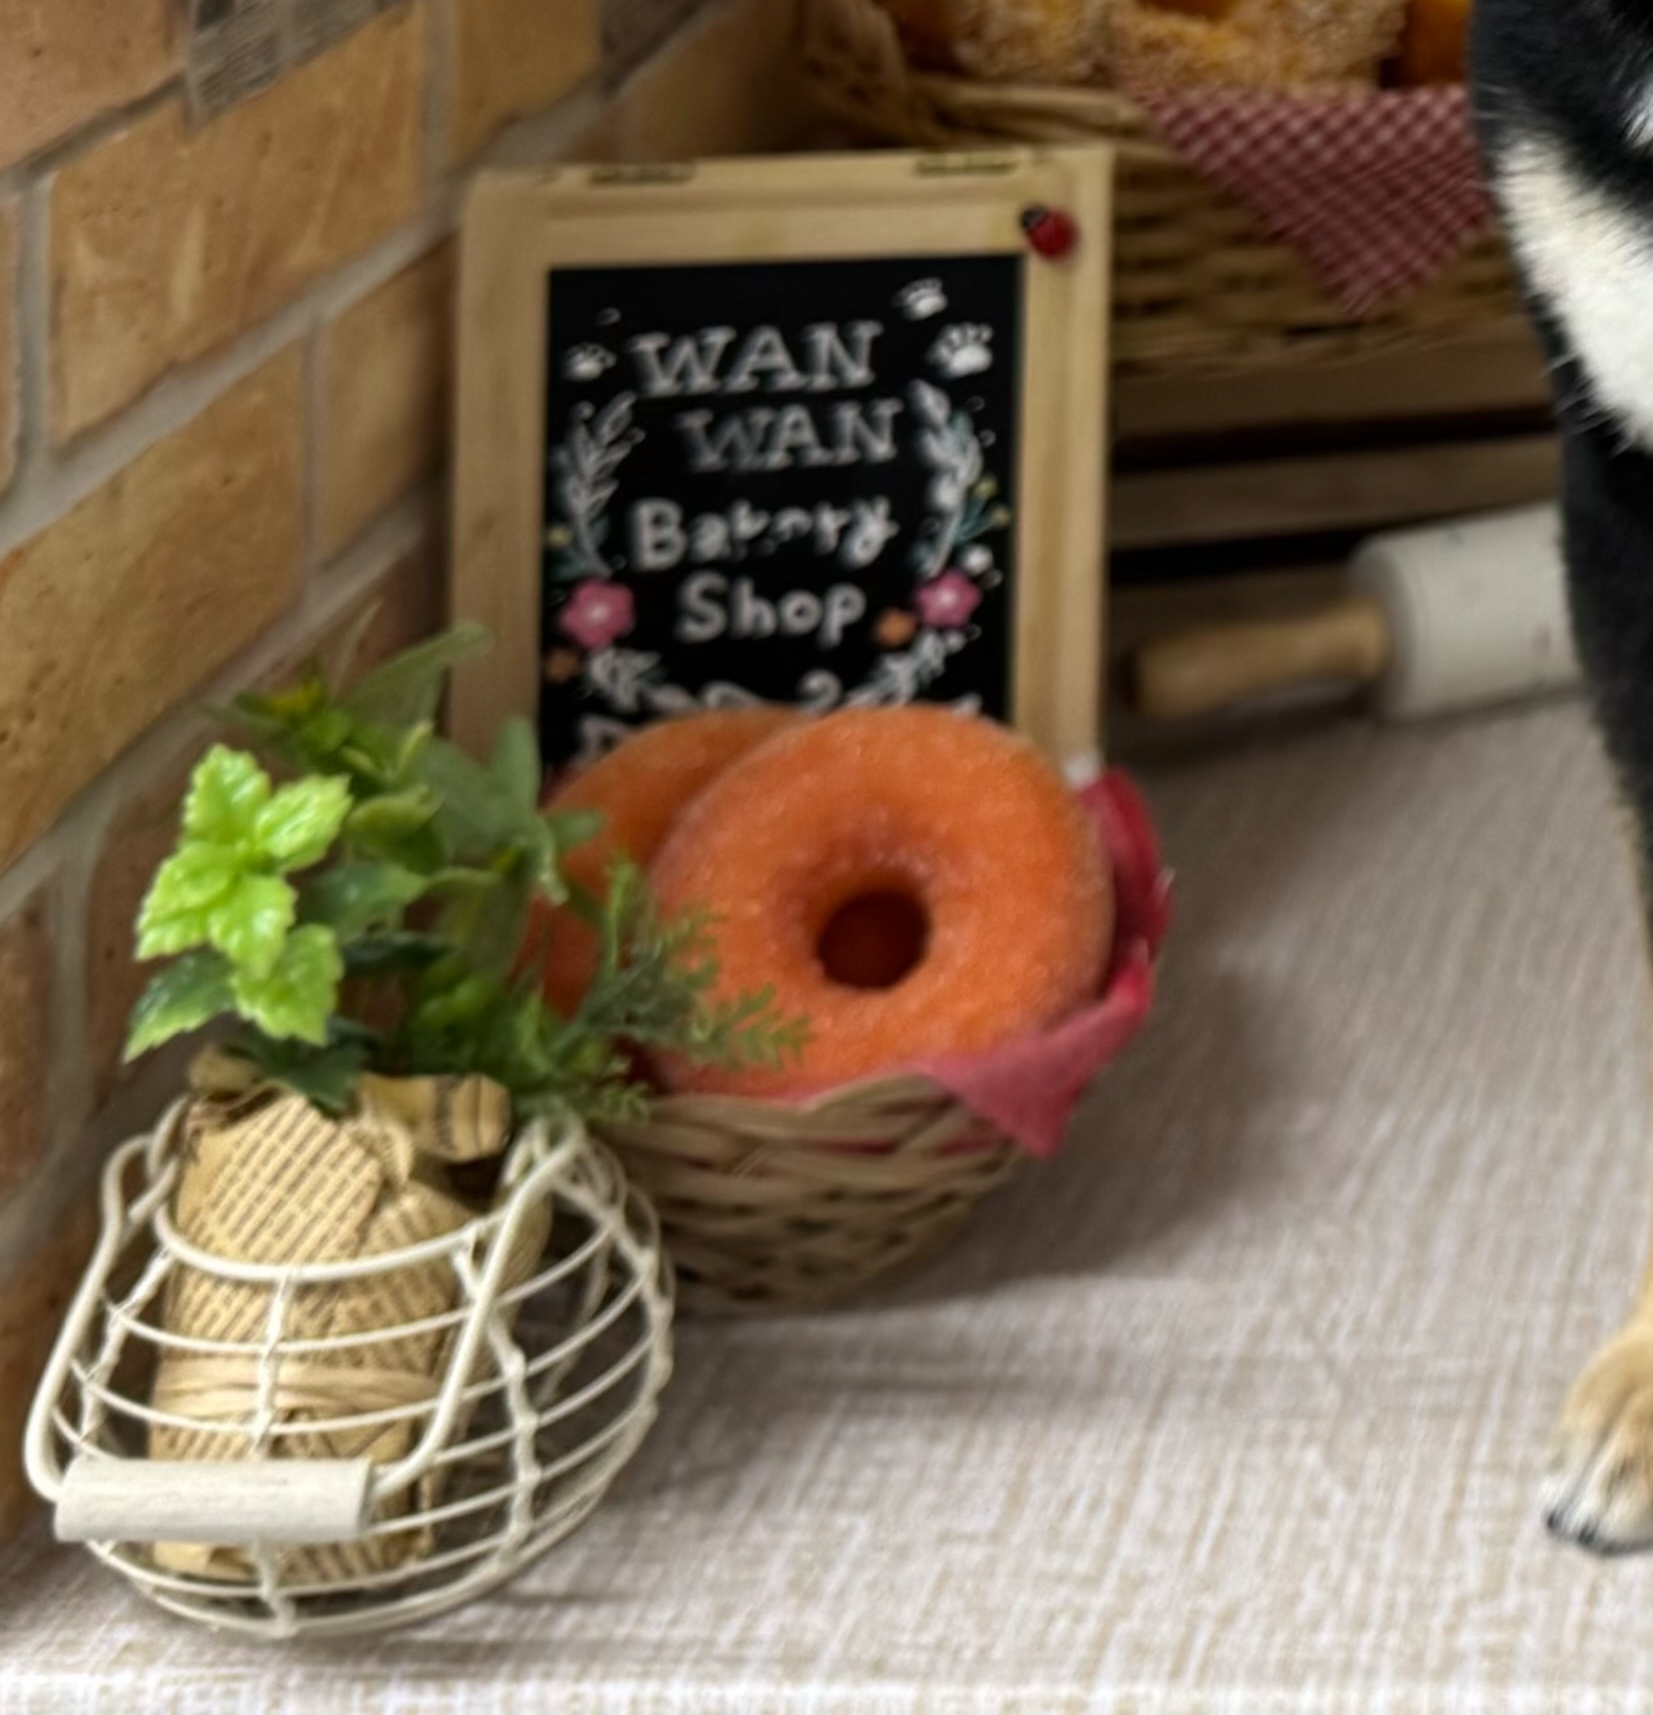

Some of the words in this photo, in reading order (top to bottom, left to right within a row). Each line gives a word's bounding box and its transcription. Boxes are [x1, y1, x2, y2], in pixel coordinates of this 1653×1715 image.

[628, 321, 884, 395] WAN
[676, 400, 904, 472] WAN
[674, 571, 868, 651] Shop
